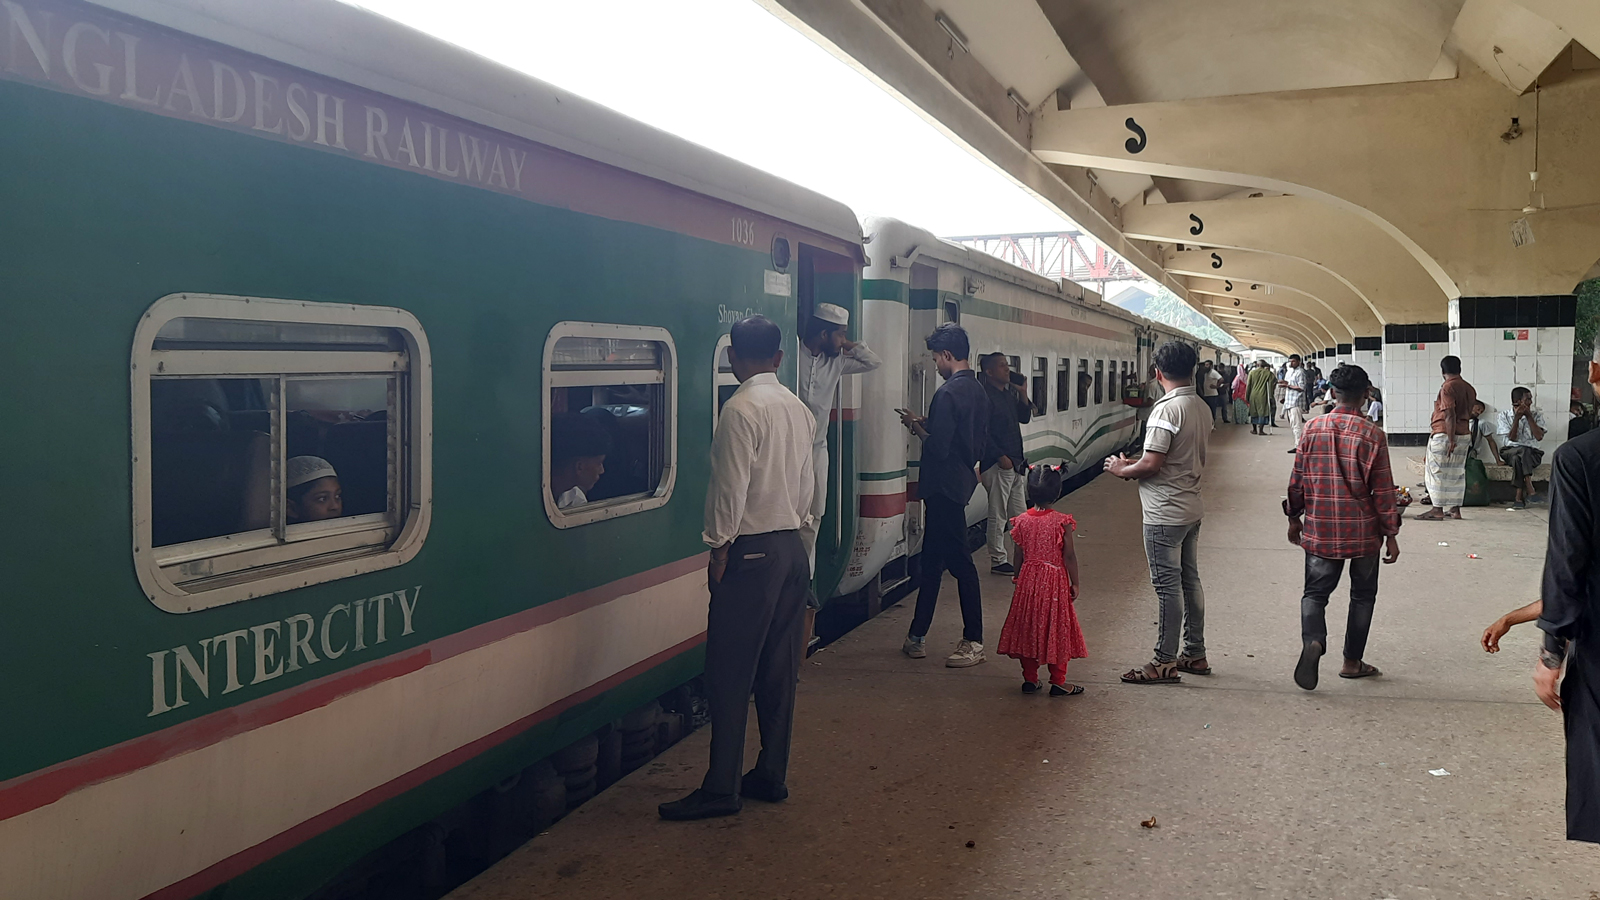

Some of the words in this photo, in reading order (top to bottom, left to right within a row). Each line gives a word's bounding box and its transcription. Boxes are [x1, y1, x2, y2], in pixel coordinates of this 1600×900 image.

[363, 105, 527, 192] RAILWAY
[731, 217, 755, 246] 1036
[147, 584, 422, 718] INTERCITY
